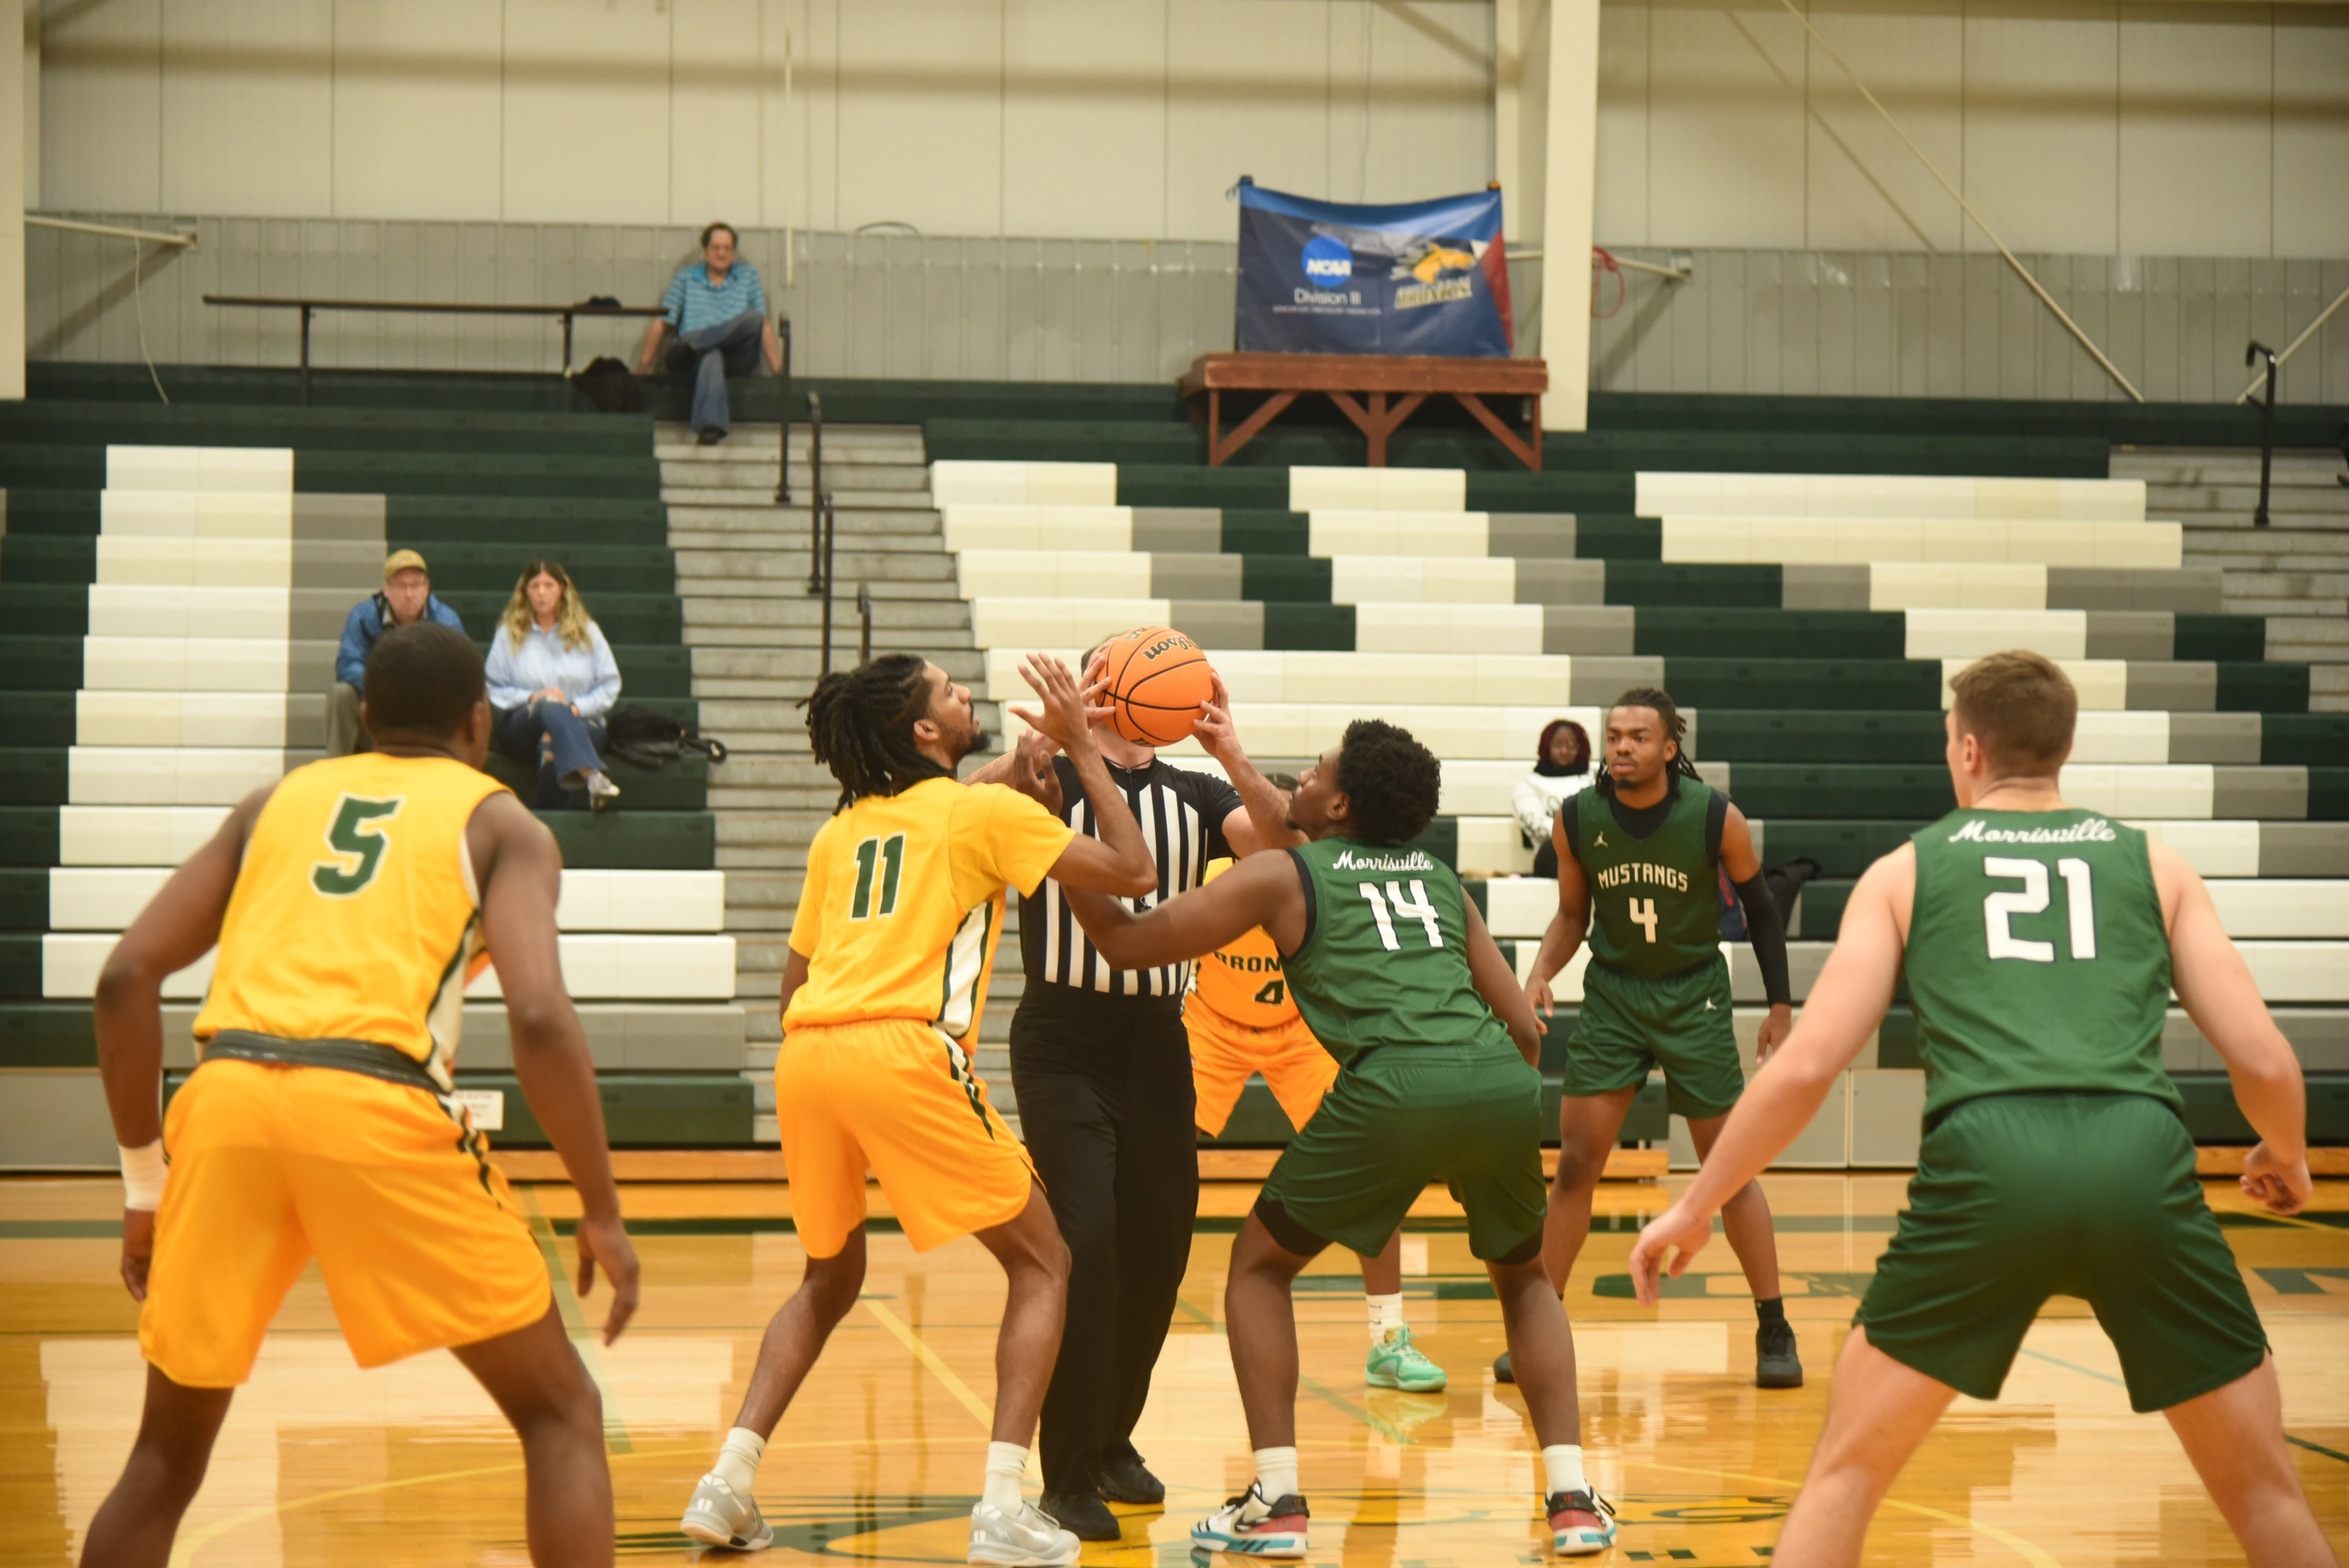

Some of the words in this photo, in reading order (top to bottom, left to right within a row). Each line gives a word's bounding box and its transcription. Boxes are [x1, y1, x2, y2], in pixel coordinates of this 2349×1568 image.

[1294, 287, 1348, 305] Division
[309, 792, 407, 899] 5
[1948, 818, 2117, 843] Morrisville
[850, 832, 906, 921] 11
[1333, 849, 1434, 872] Morrisville
[1597, 863, 1688, 893] MUSTANGS
[1358, 879, 1444, 951] 14
[1629, 897, 1658, 943] 4
[1984, 856, 2096, 962] 21
[1254, 979, 1284, 1005] 4
